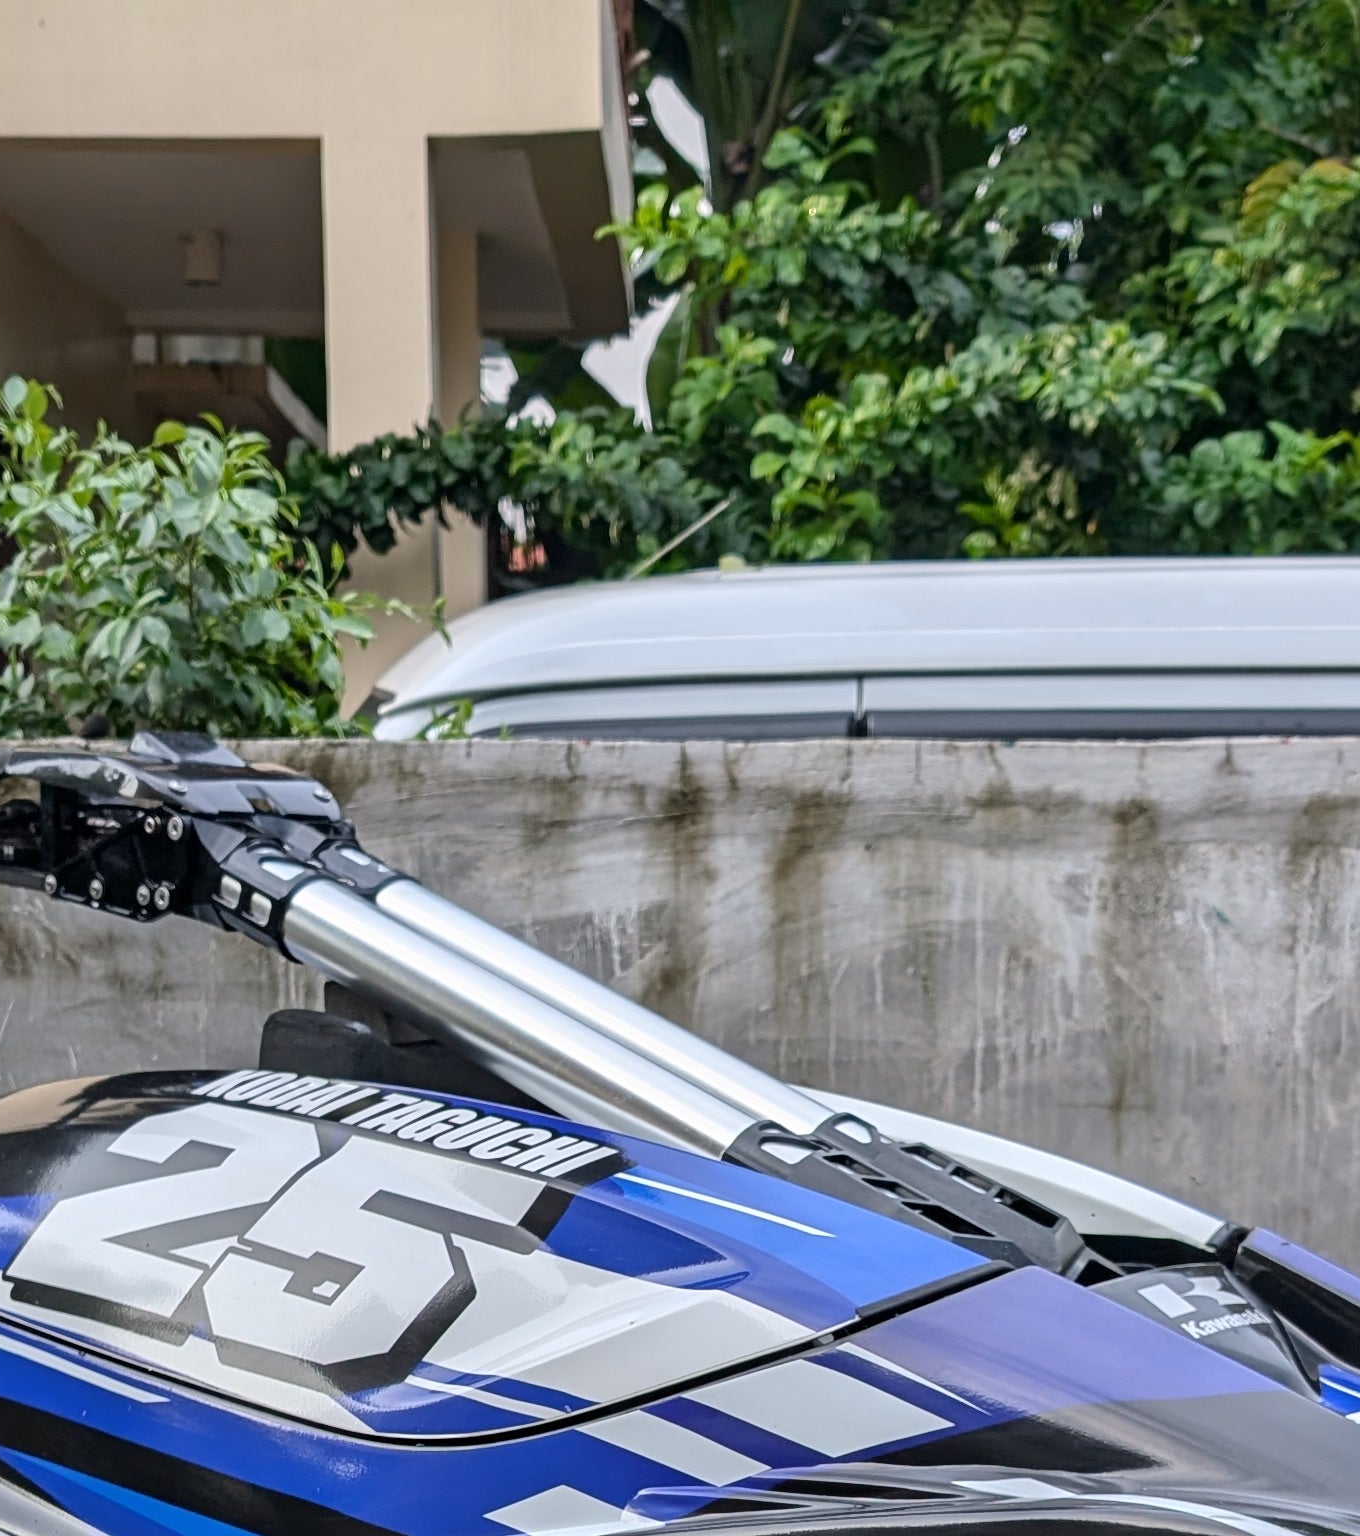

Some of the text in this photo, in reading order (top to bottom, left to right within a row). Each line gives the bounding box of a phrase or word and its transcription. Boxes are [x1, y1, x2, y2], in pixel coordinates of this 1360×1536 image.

[192, 1071, 618, 1178] KODAI TAGUCHI
[2, 1101, 548, 1366] 25
[1181, 1308, 1273, 1339] Kawasaki
